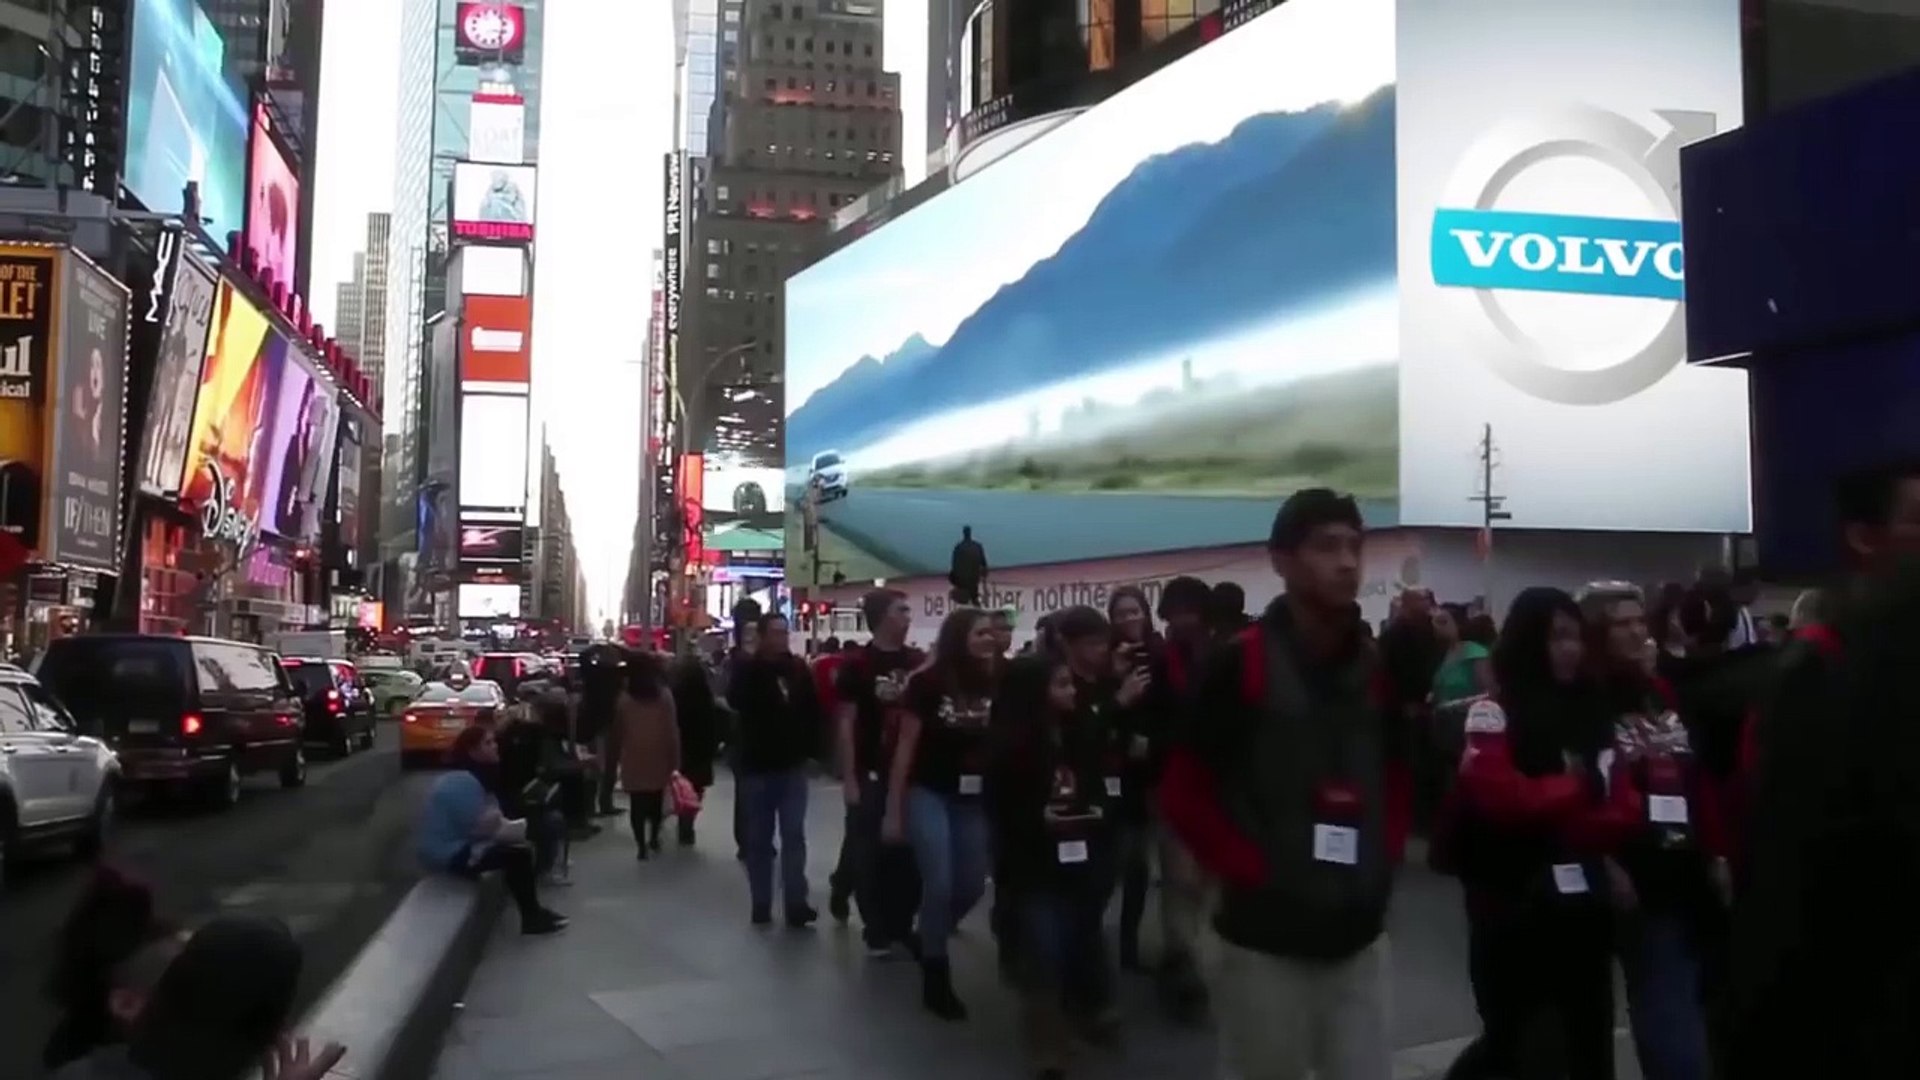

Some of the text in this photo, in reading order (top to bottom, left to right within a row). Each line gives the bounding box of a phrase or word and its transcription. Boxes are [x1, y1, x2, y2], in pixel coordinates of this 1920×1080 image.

[454, 222, 532, 241] TOSHIBA
[1449, 228, 1685, 281] VOLVO
[17, 265, 38, 281] THE
[667, 247, 681, 331] everywhere
[924, 594, 944, 617] be
[1034, 583, 1070, 612] not
[1071, 581, 1106, 609] the
